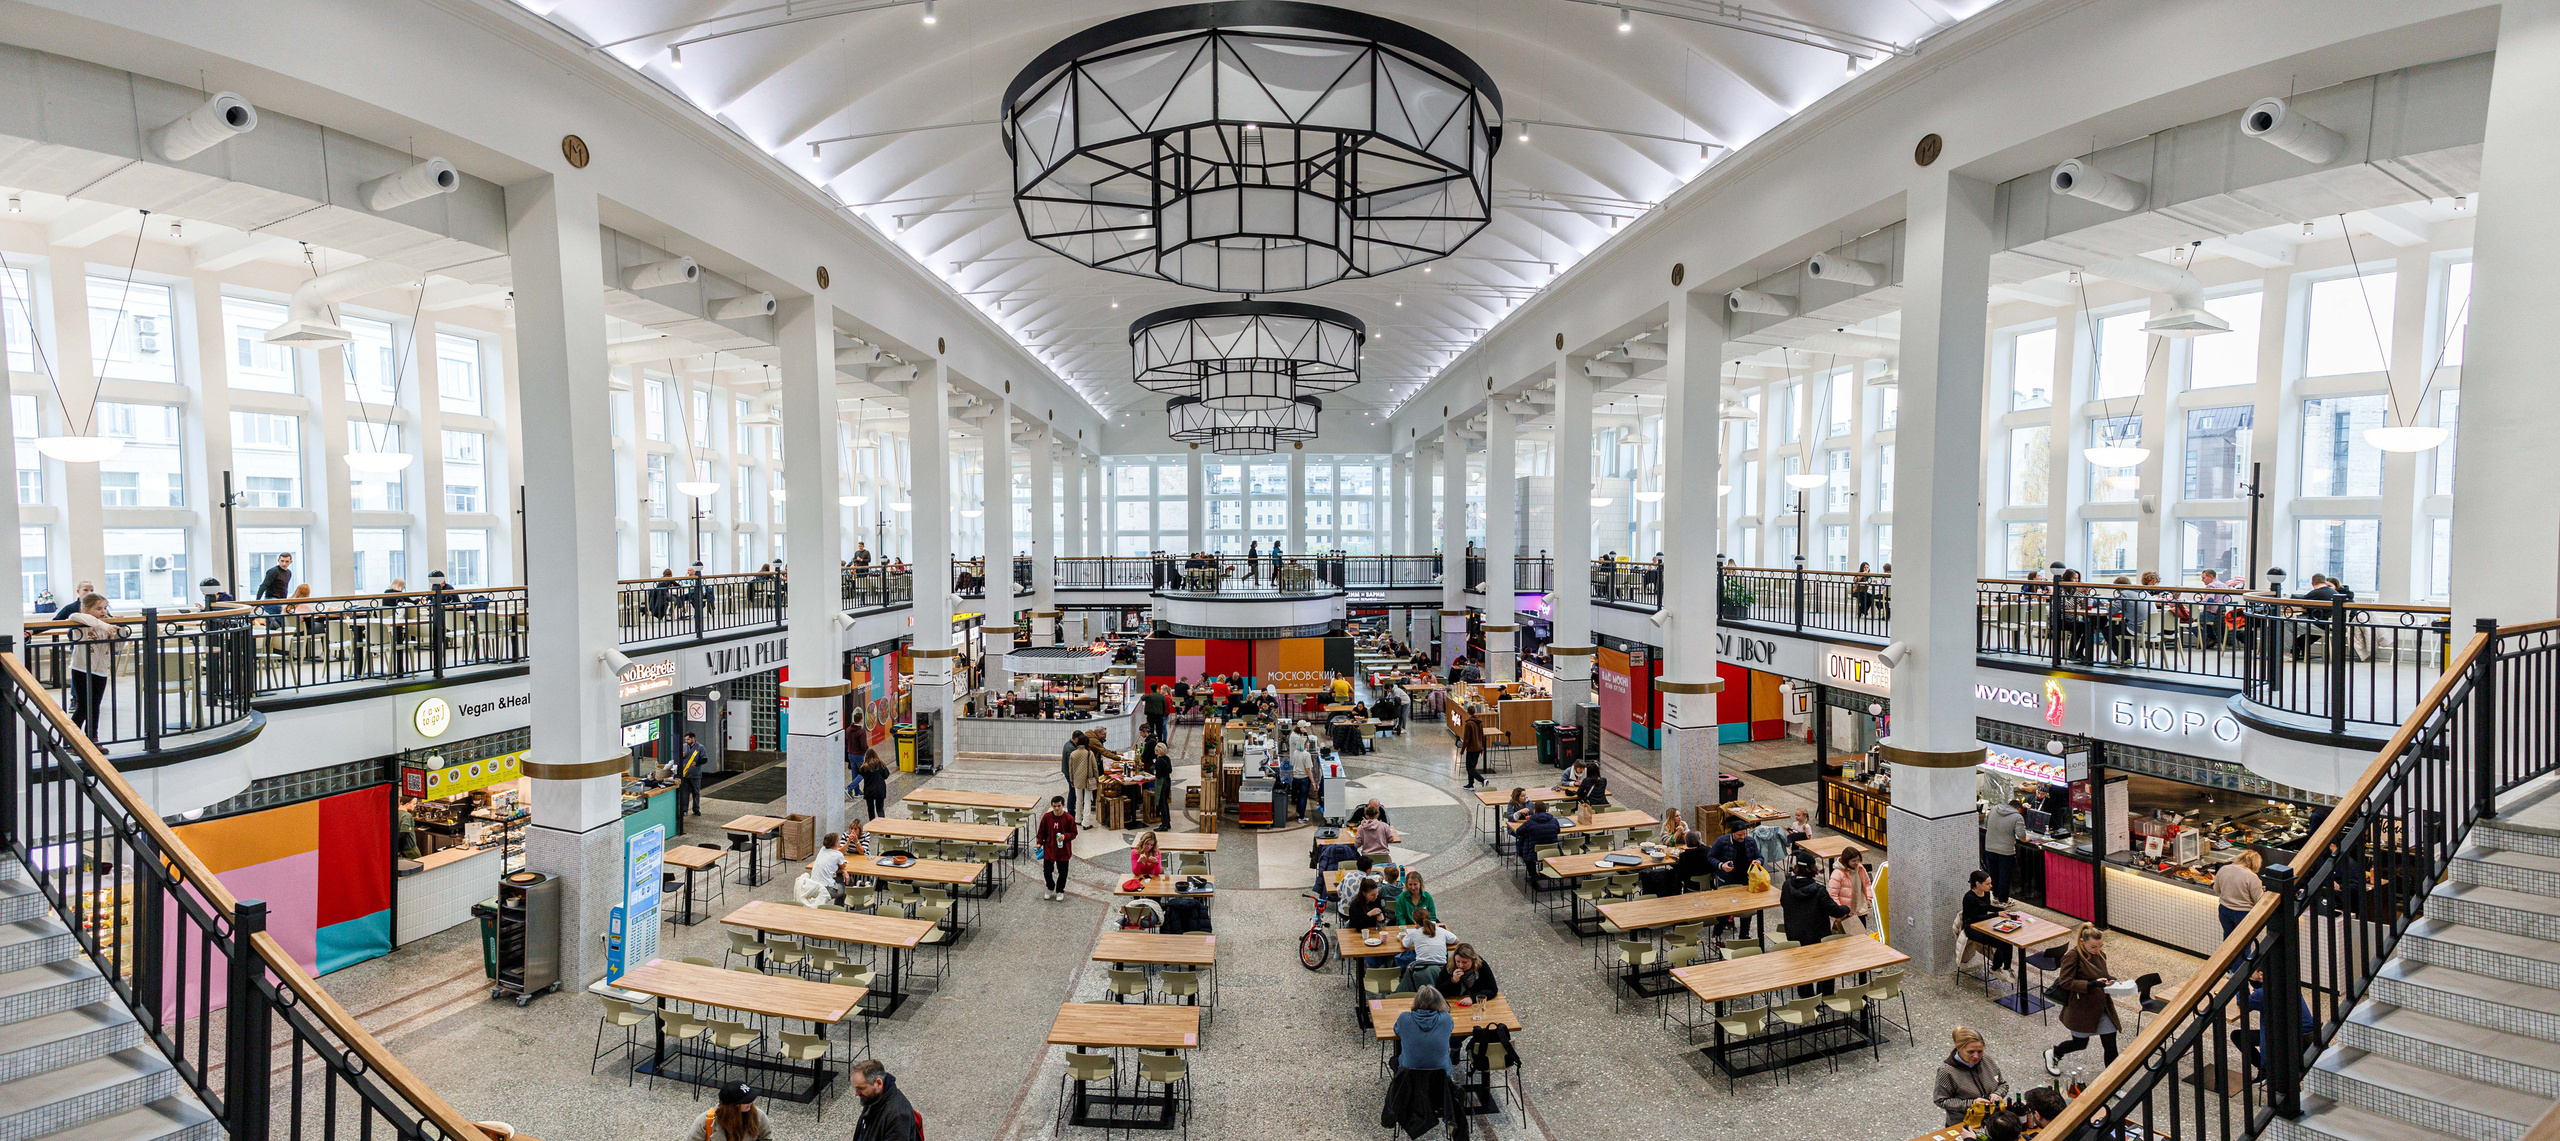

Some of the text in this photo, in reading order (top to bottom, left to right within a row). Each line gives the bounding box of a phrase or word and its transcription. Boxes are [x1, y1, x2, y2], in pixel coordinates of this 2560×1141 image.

[706, 645, 750, 677] УЛИЦА
[1736, 636, 1776, 665] ДВОР
[1267, 667, 1336, 681] МОСКОВСКИЙ
[458, 692, 531, 717] Vegan &Heal
[2112, 700, 2241, 743] БЮРО
[2067, 761, 2086, 770] БЮРО
